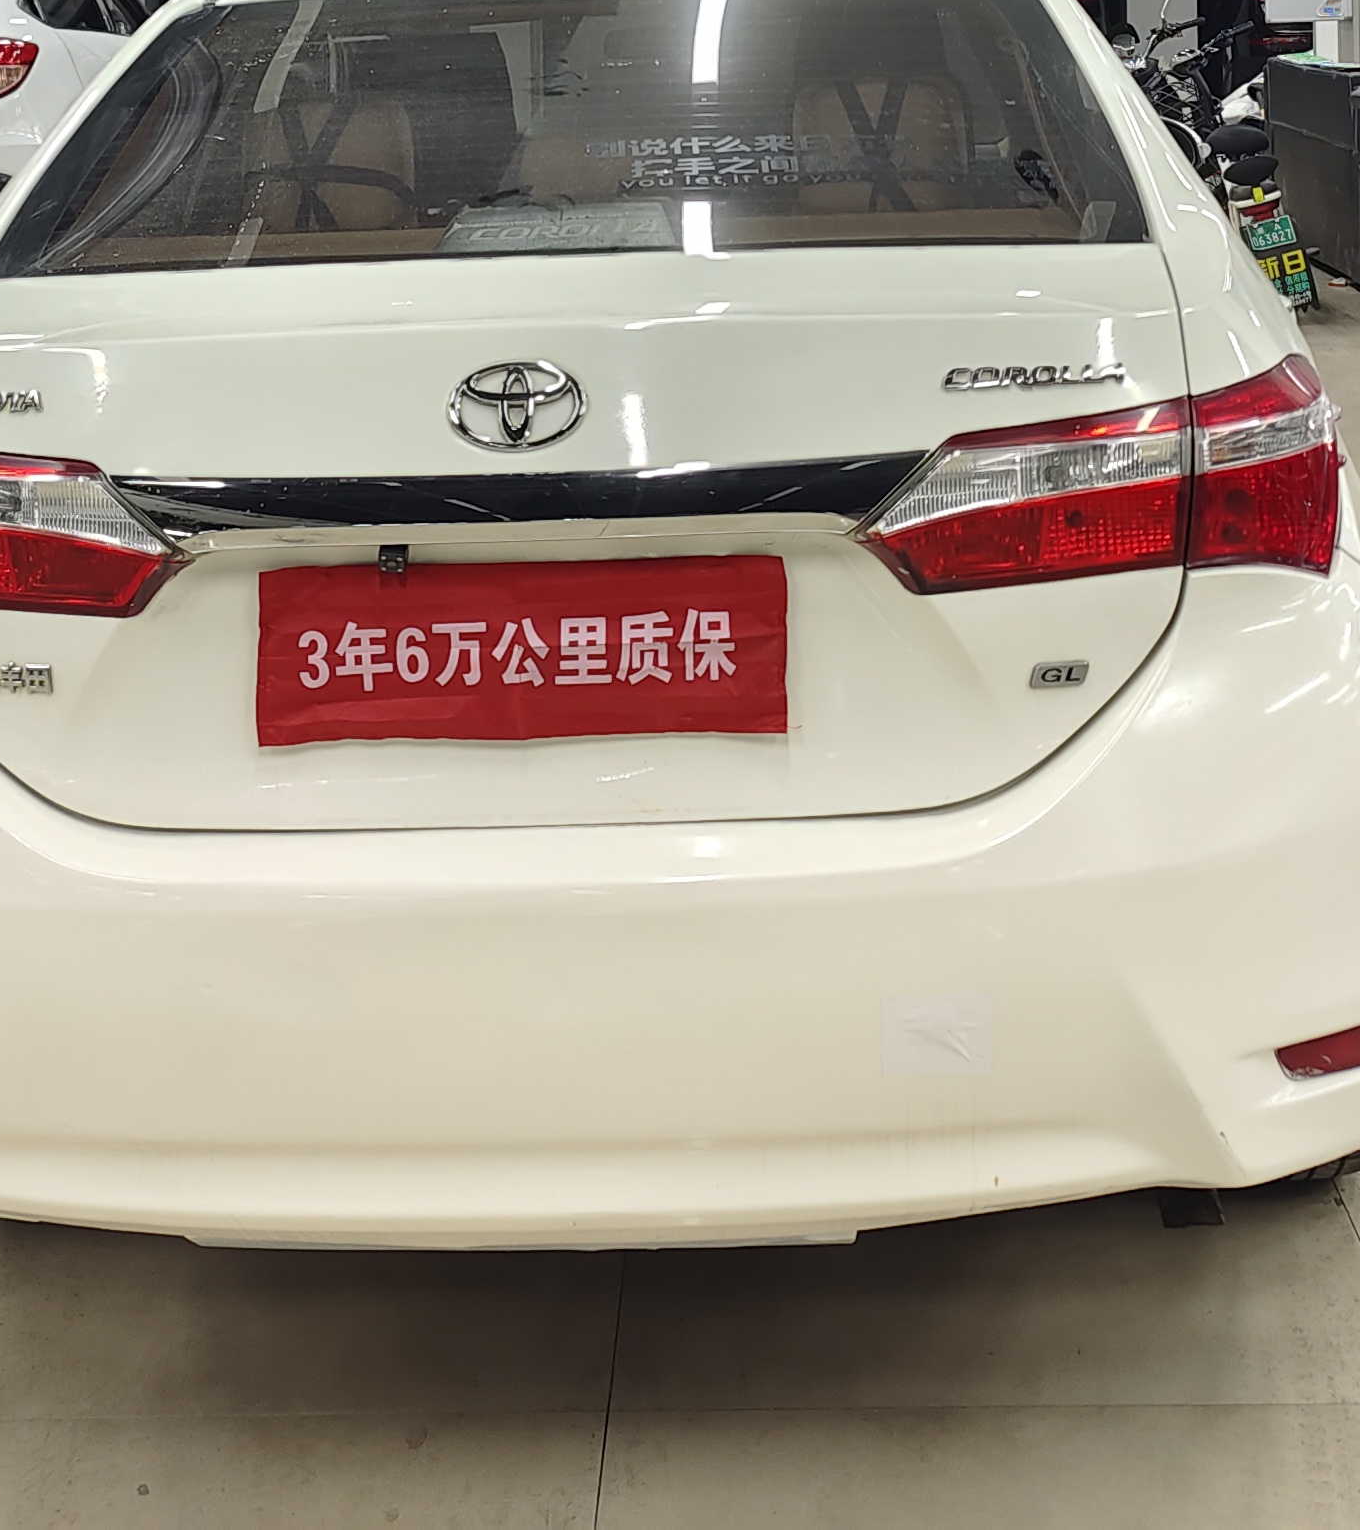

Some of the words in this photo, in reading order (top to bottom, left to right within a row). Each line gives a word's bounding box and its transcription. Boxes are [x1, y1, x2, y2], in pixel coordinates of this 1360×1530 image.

[1251, 228, 1293, 248] 063827
[943, 363, 1127, 391] COROLLA
[297, 608, 738, 692] 3年6万公里质保
[1041, 667, 1081, 683] GL
